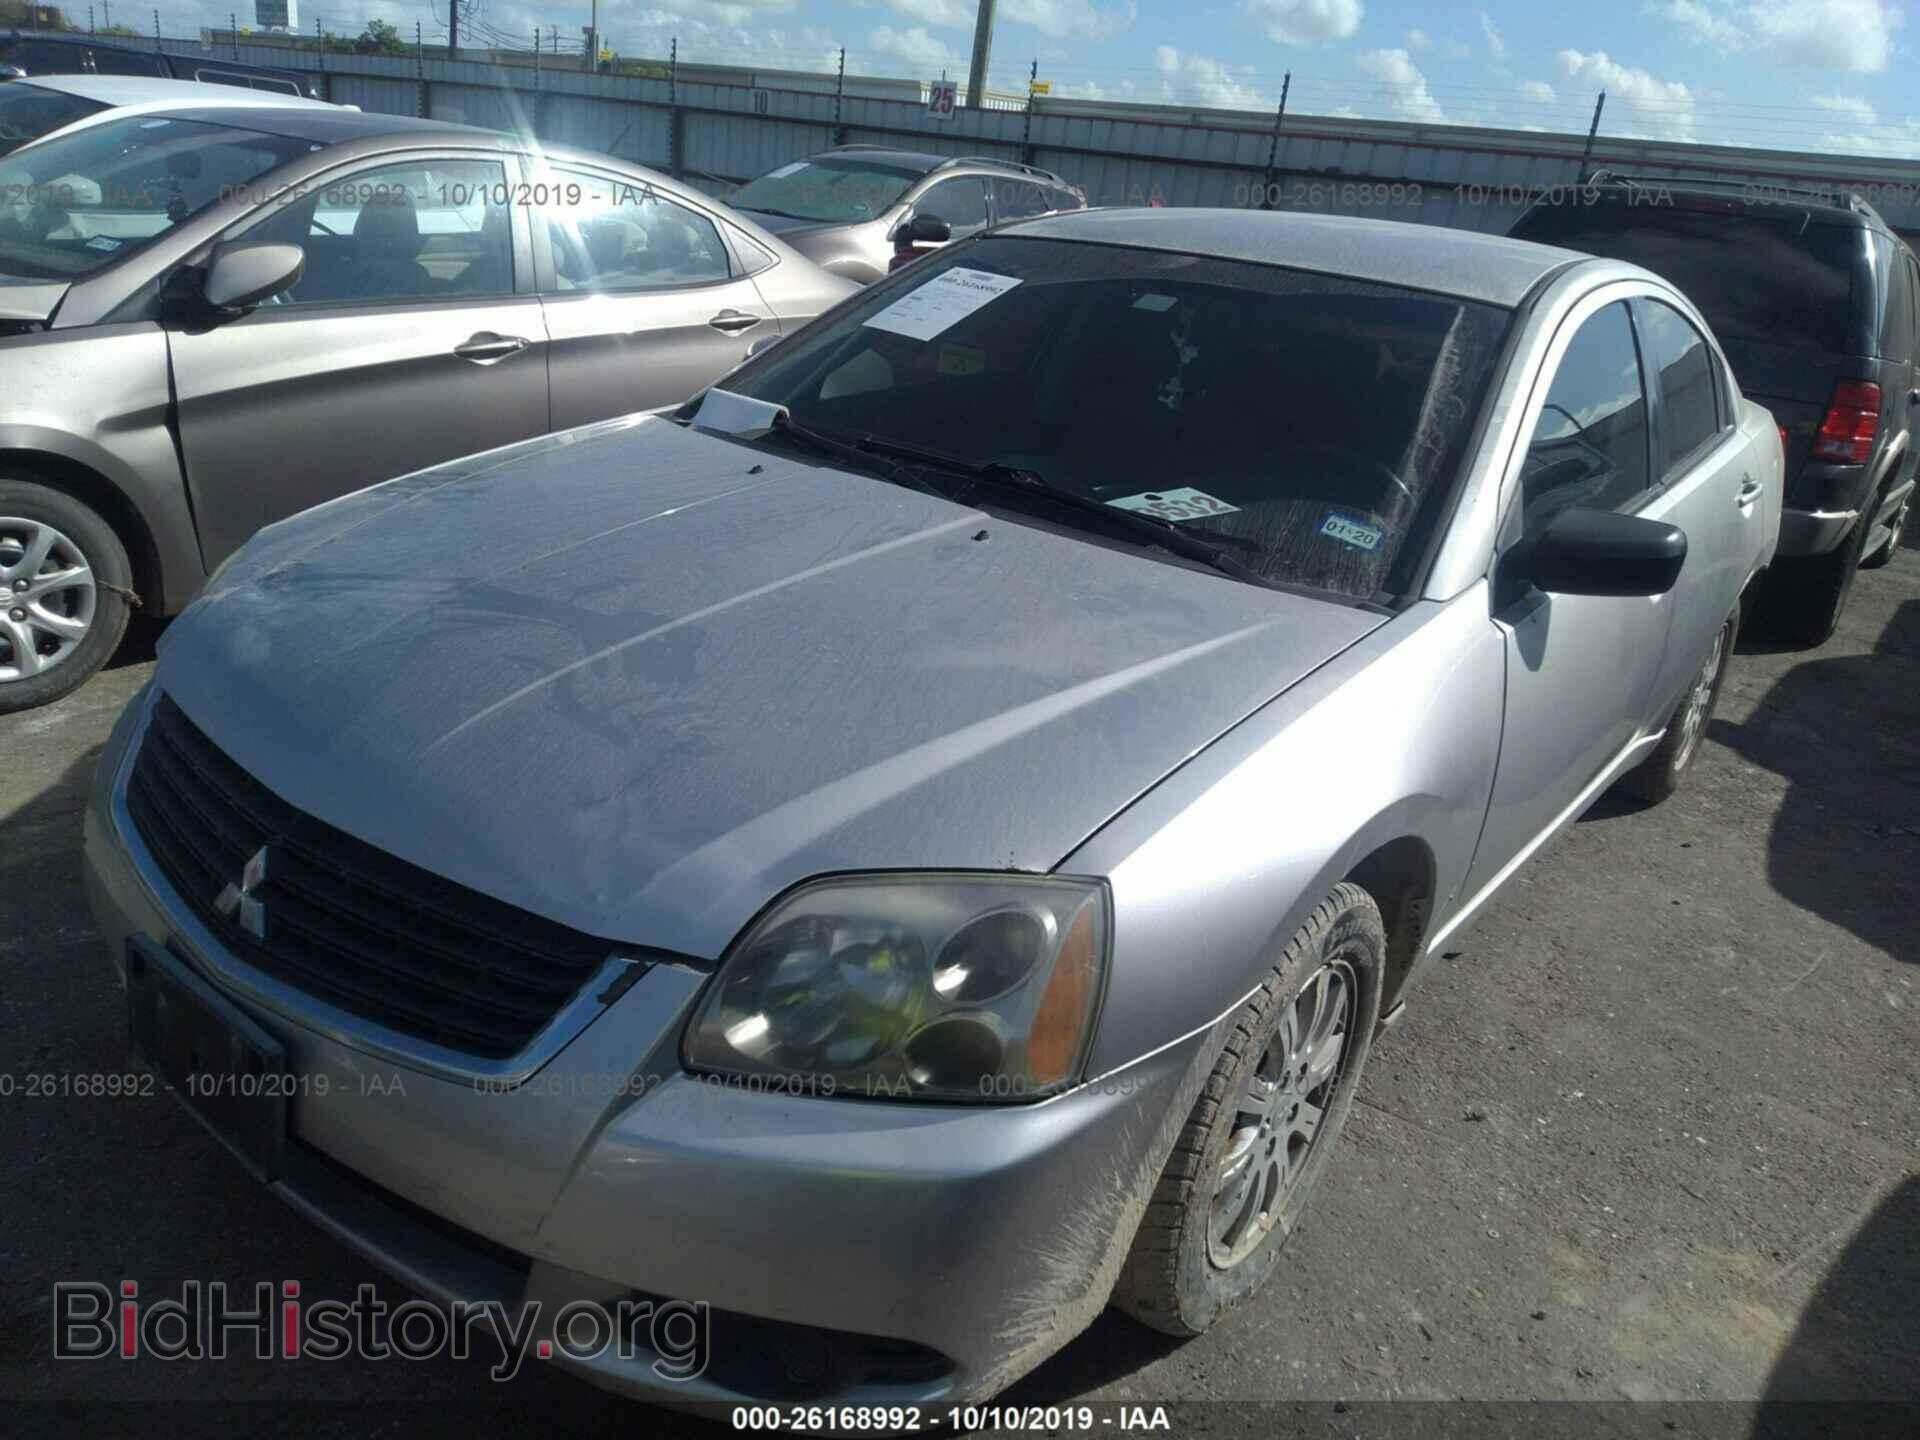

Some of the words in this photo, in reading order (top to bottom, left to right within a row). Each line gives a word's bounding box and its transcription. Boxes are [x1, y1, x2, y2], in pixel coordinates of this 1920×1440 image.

[753, 91, 768, 114] 10
[930, 87, 954, 113] 25
[1351, 530, 1375, 545] 20
